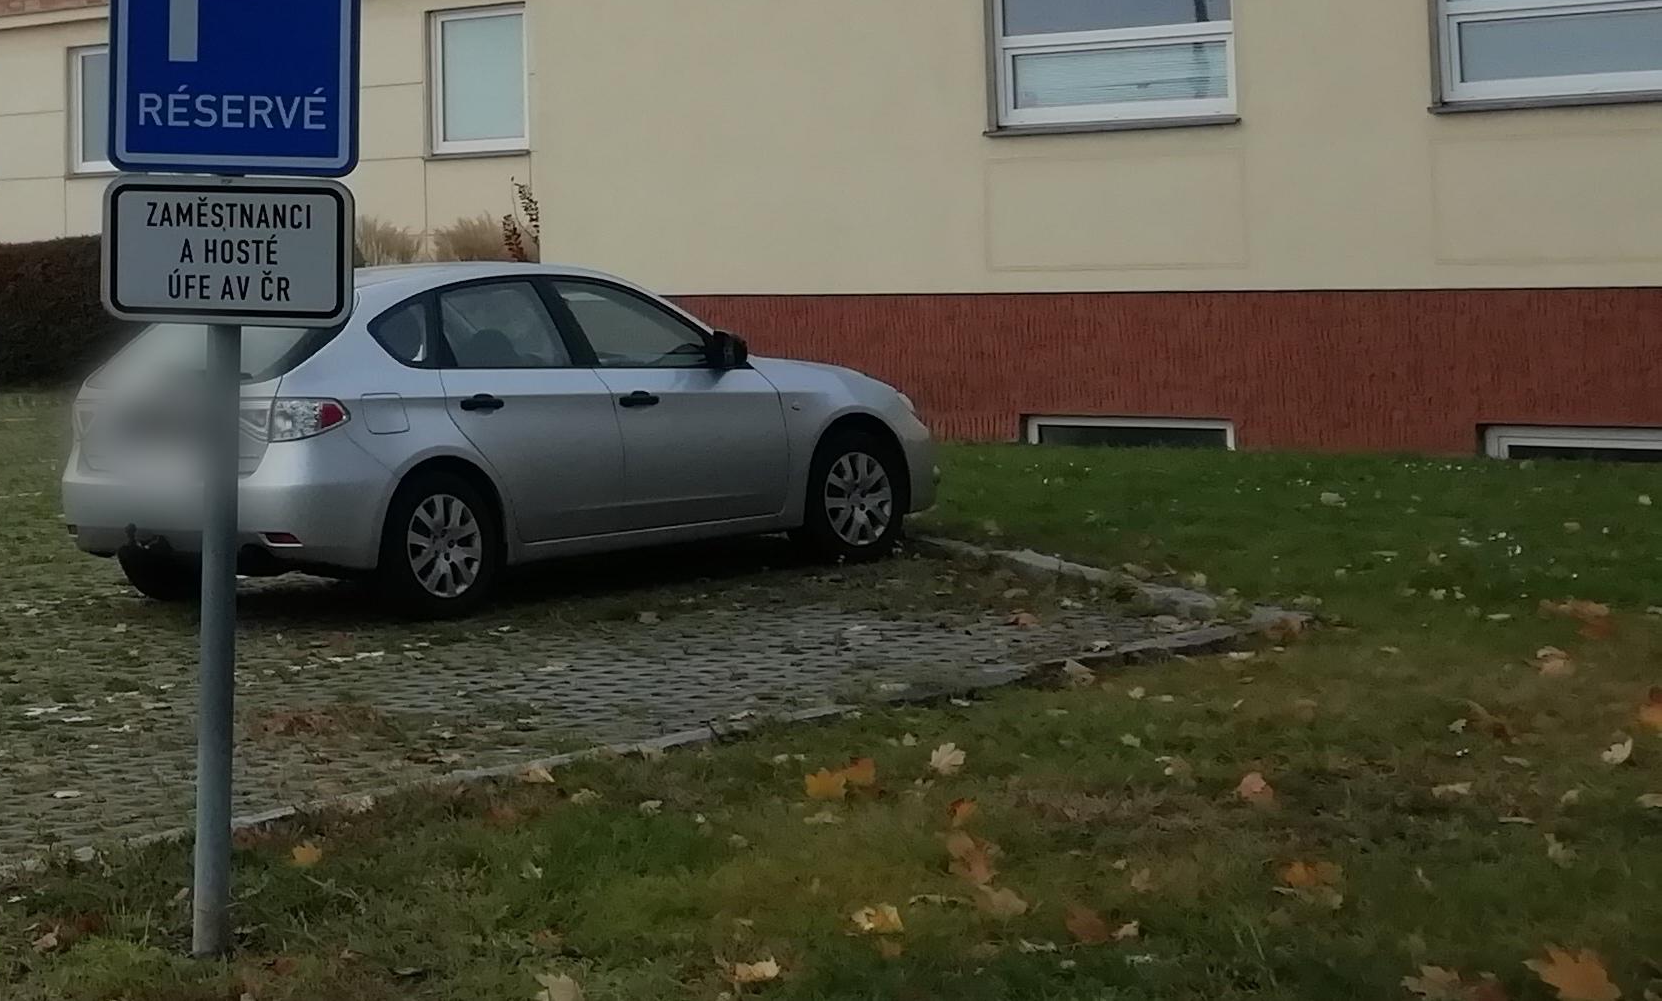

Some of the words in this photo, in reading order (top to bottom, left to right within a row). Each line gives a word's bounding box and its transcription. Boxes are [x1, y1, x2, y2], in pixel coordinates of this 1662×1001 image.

[137, 84, 327, 130] RÉSERVÉ
[146, 196, 312, 230] ZAMĚSTNANCI
[179, 238, 194, 264] A
[204, 234, 279, 265] HOSTÉ
[167, 268, 211, 300] ÚFE
[220, 275, 250, 301] AV
[260, 270, 291, 302] ČR
